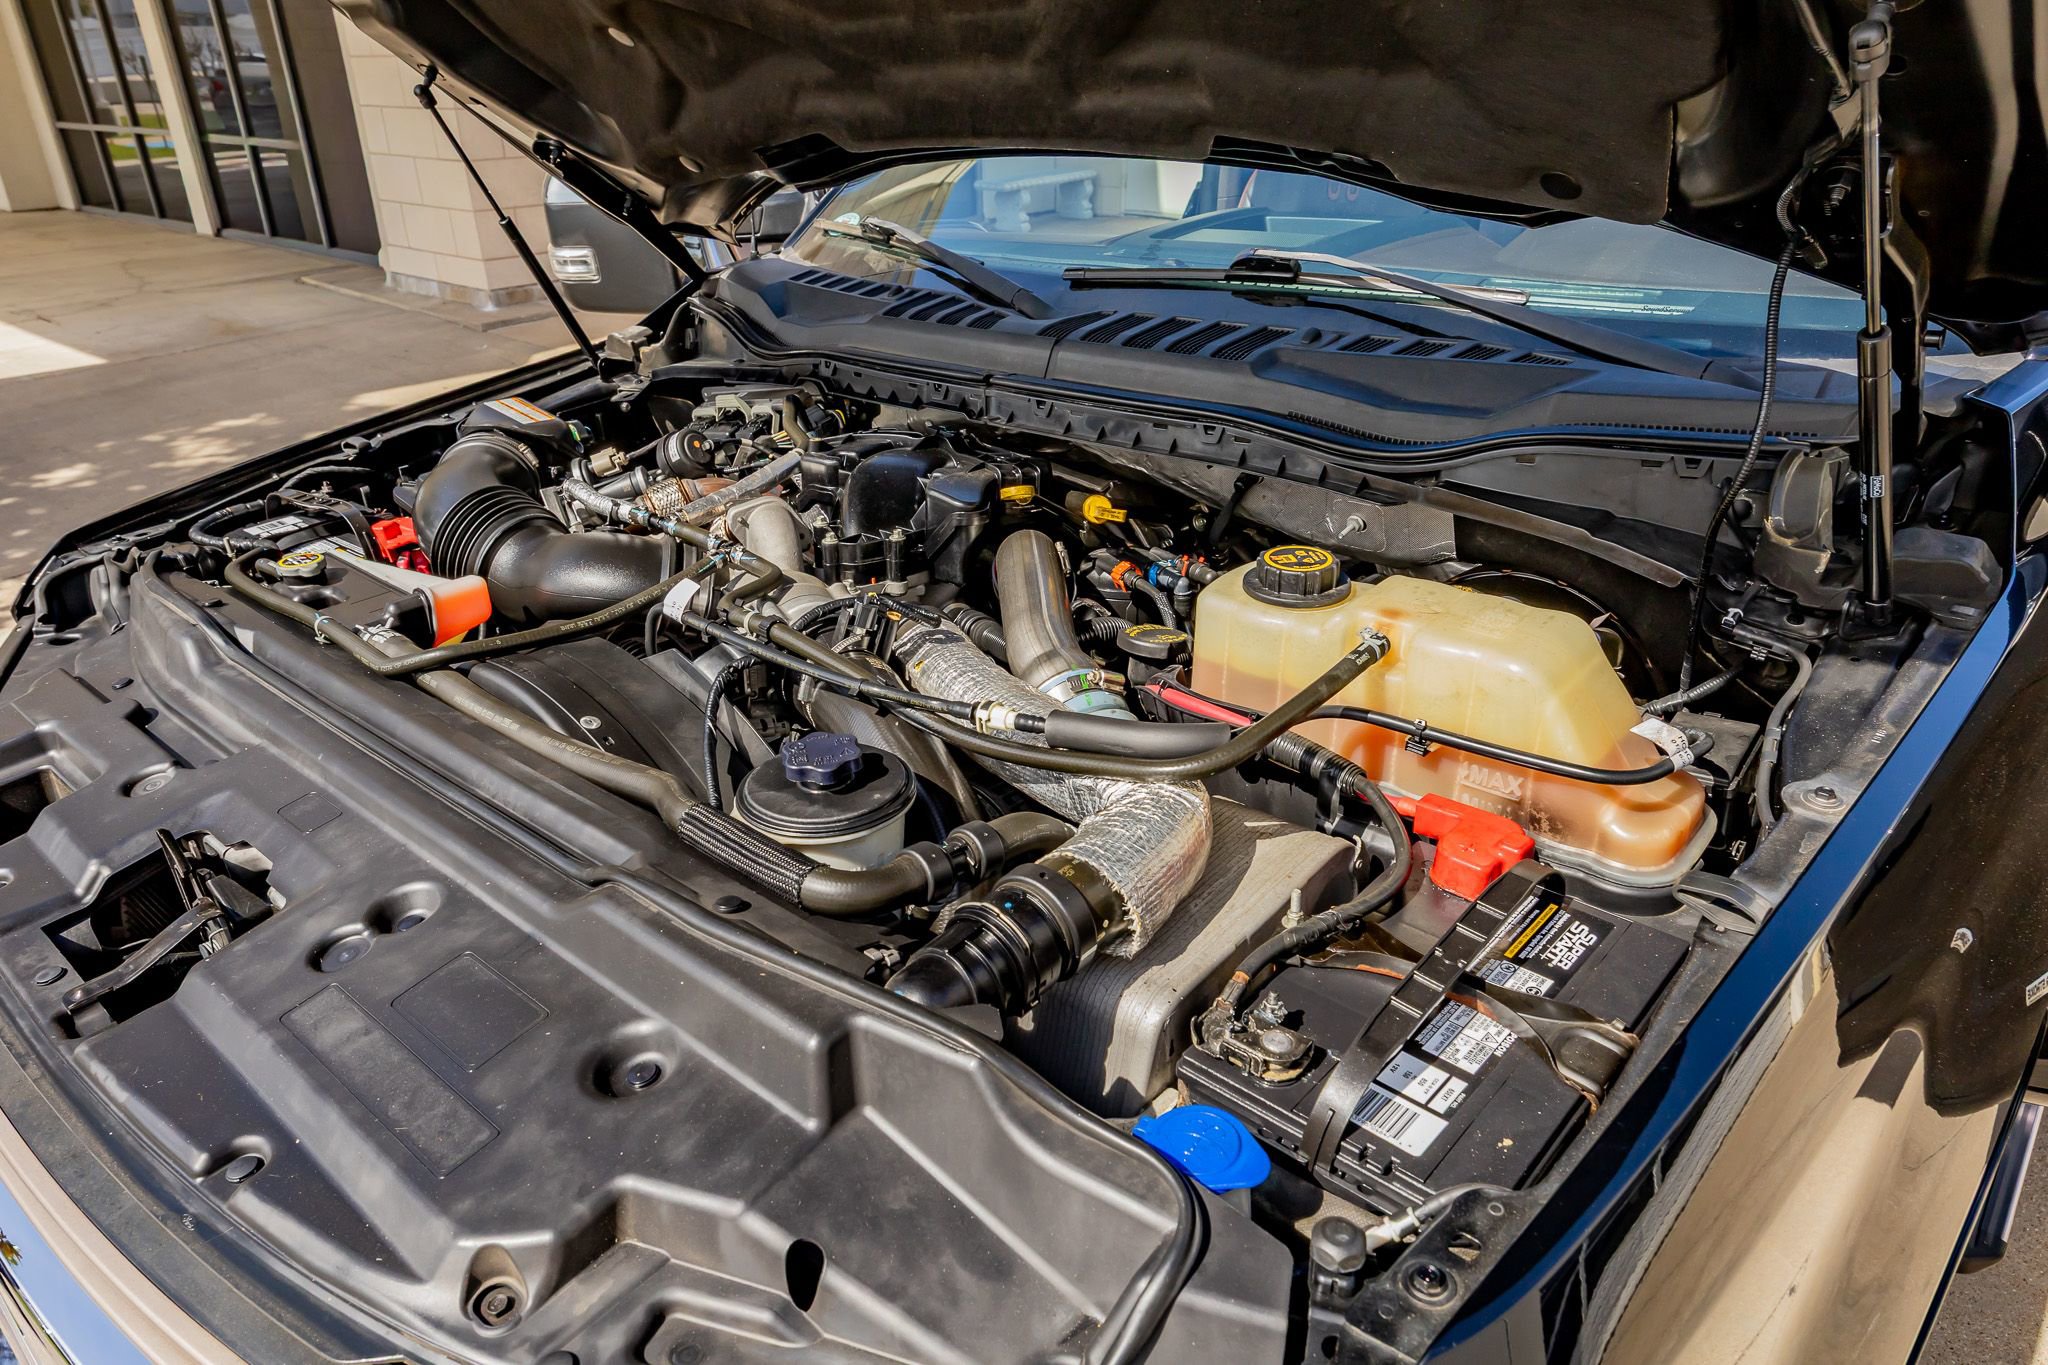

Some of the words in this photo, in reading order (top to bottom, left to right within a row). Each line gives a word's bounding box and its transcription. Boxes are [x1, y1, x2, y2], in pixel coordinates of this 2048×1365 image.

[1872, 476, 1883, 497] FoMoCo
[1469, 764, 1525, 797] MAX
[1543, 920, 1590, 964] START
[1557, 930, 1598, 970] SUPER
[1493, 1031, 1518, 1056] POISON
[1390, 1063, 1399, 1073] 12V
